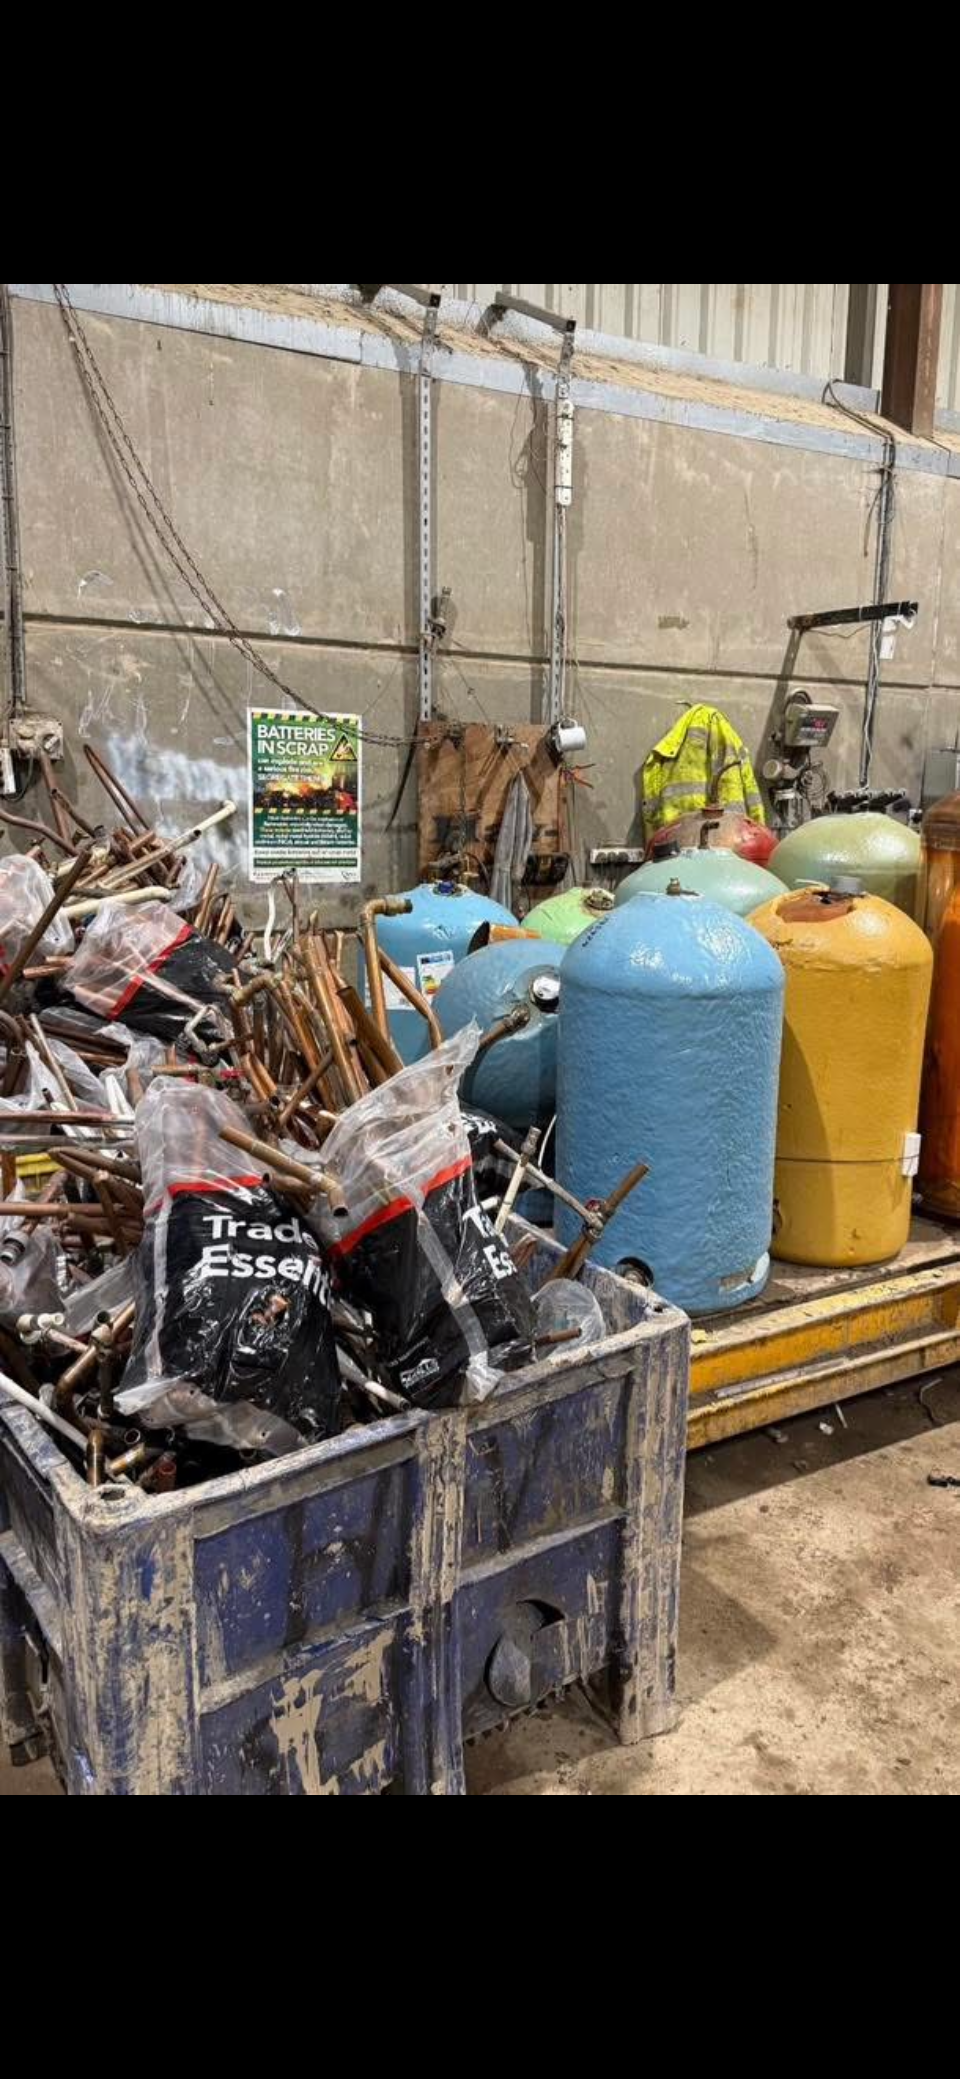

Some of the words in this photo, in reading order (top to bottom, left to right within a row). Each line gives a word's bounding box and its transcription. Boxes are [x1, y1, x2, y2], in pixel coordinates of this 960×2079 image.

[257, 724, 336, 743] BATTERIES
[257, 740, 275, 755] IN
[276, 741, 329, 757] SCRAP
[202, 1214, 319, 1251] Trade
